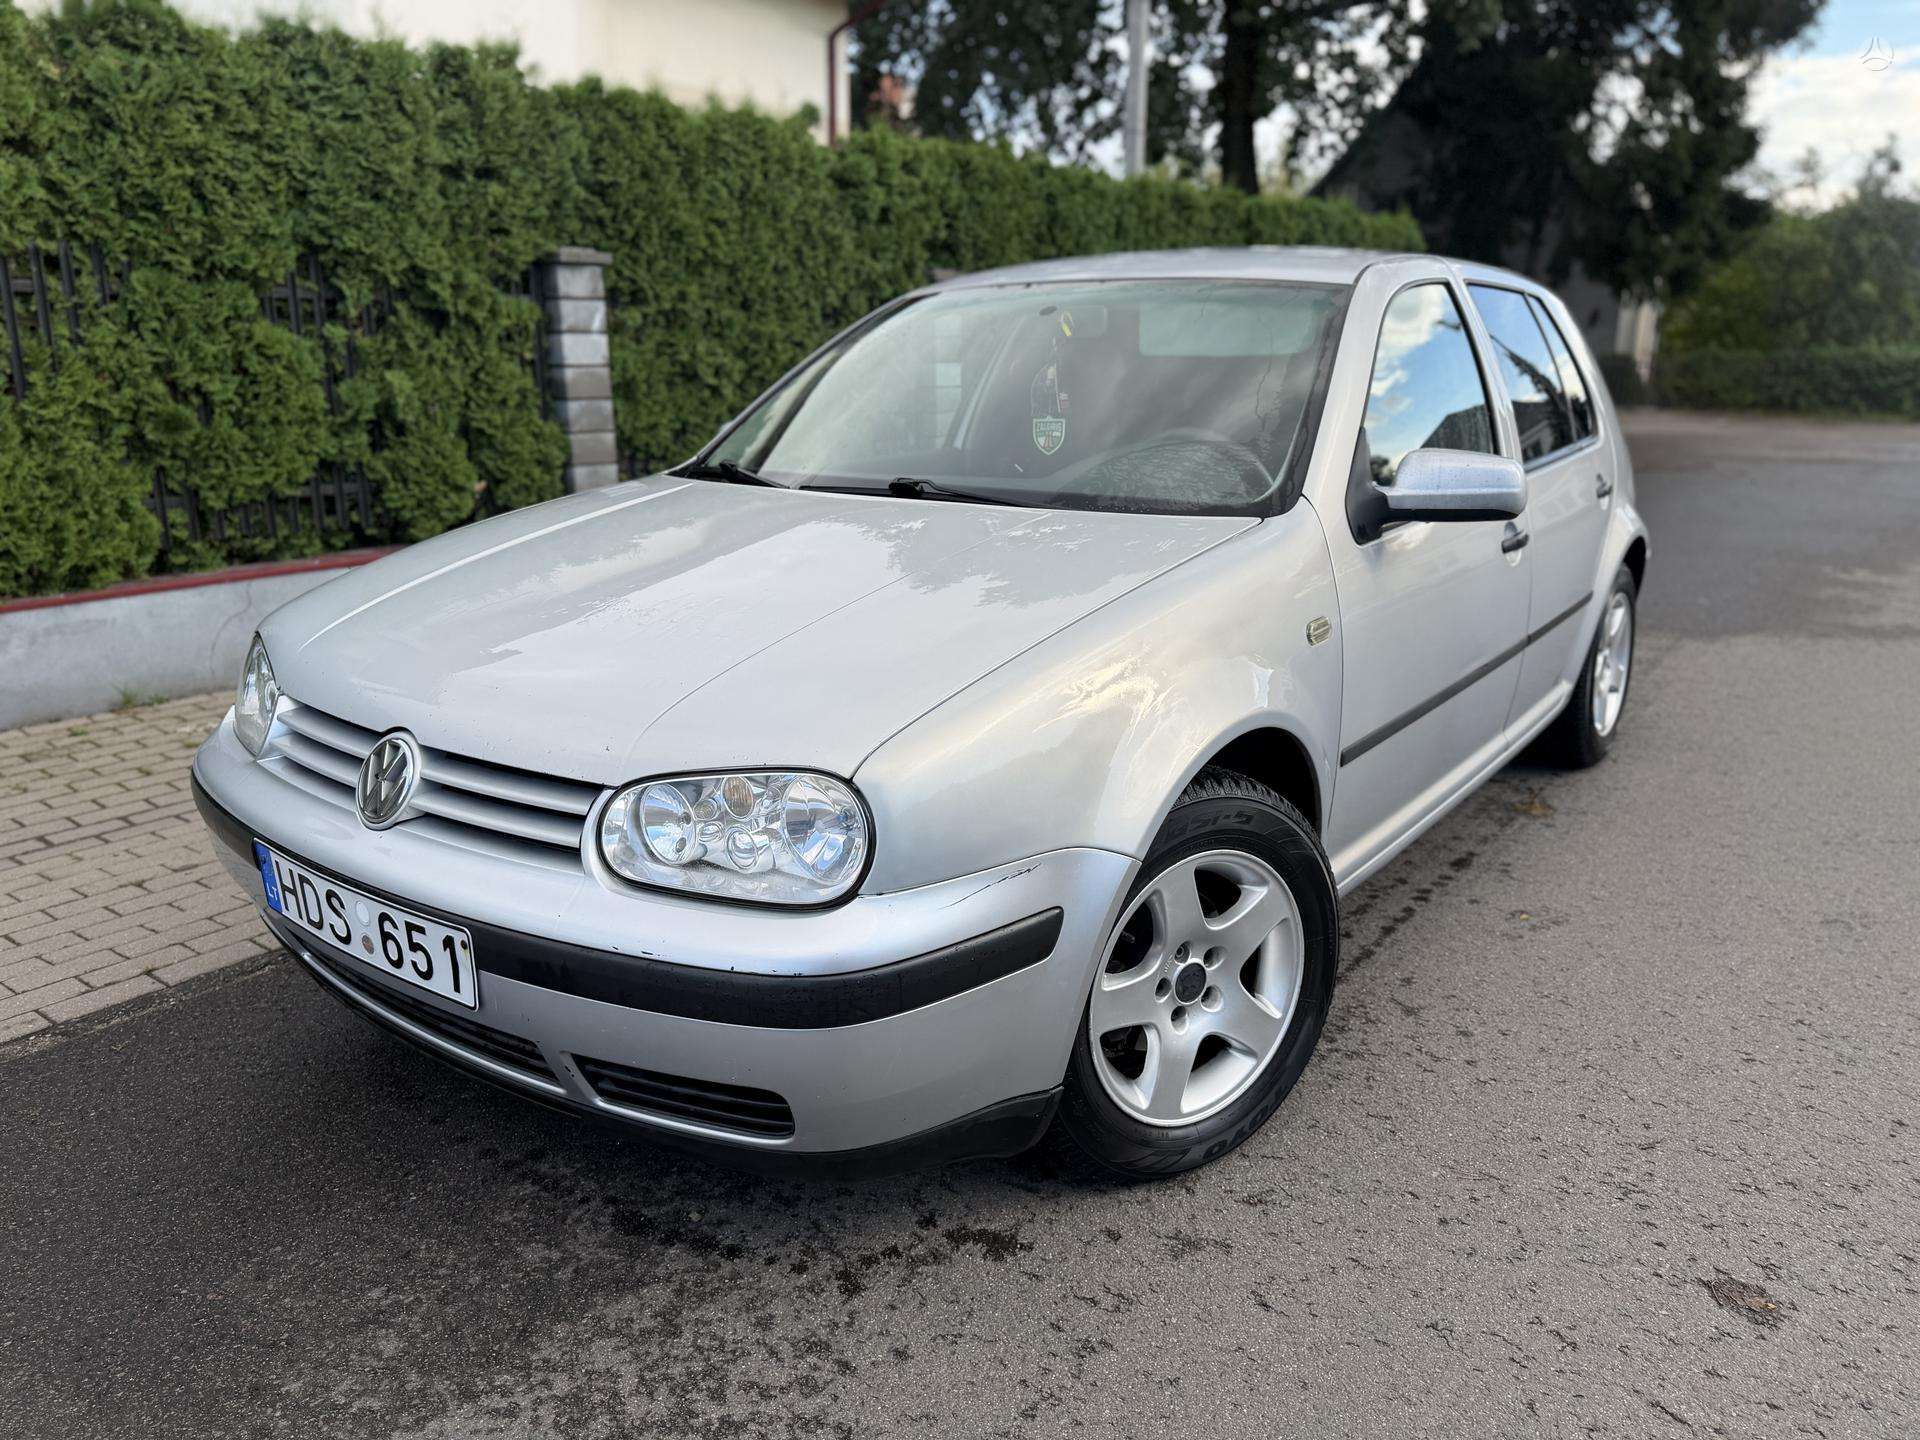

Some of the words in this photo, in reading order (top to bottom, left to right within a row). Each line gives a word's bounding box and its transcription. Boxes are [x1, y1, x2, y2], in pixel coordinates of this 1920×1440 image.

[266, 882, 278, 901] LT
[274, 859, 352, 945] HDS
[377, 911, 461, 994] 651
